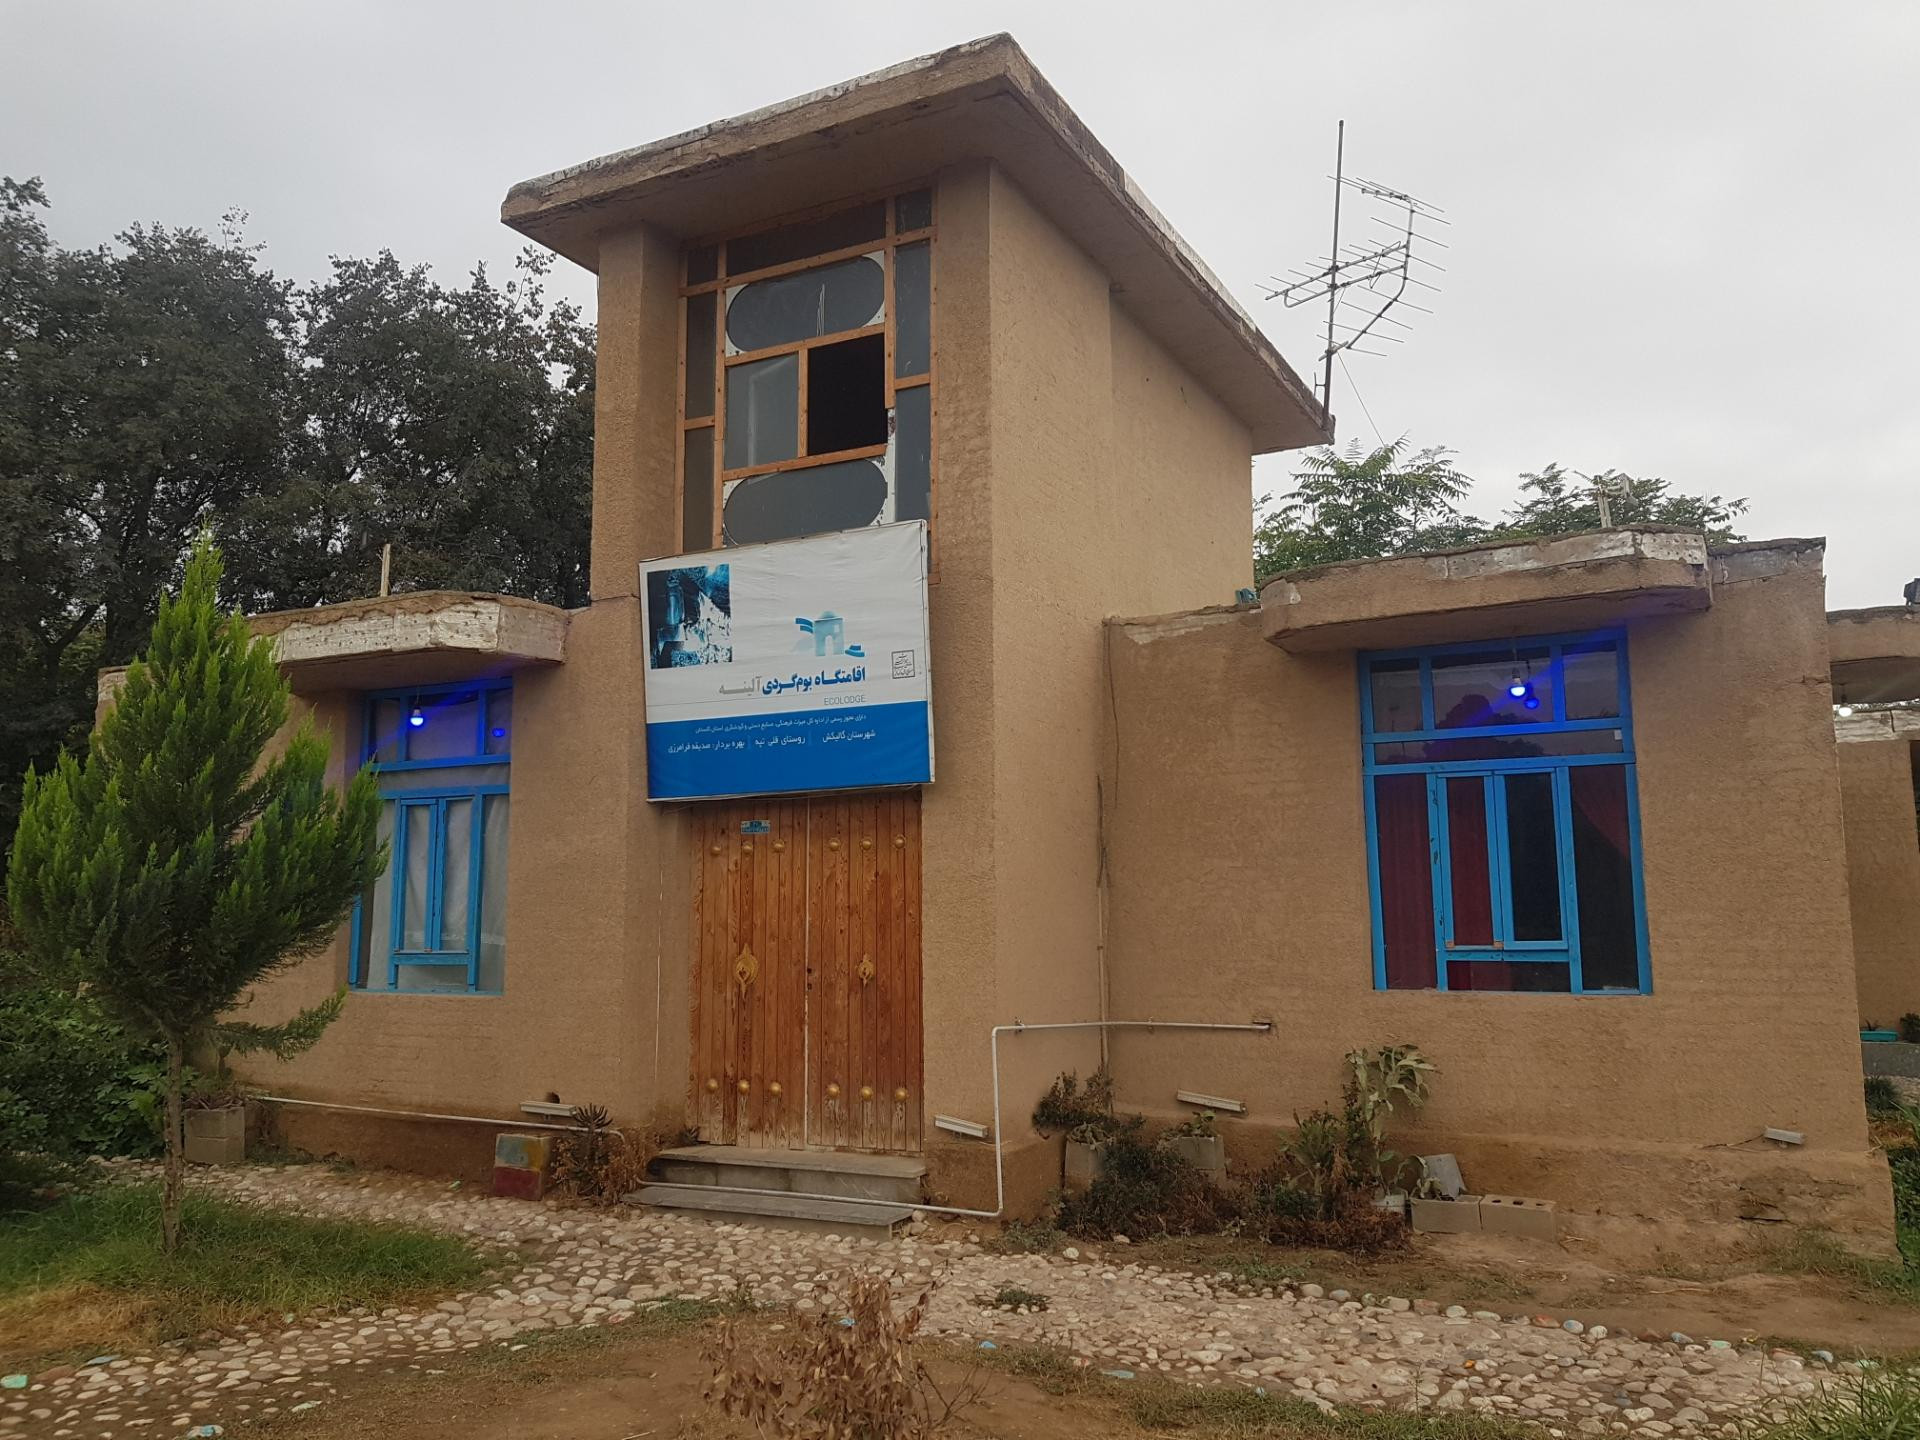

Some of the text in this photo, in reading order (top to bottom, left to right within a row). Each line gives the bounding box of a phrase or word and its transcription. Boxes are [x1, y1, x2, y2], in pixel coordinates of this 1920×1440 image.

[814, 666, 866, 686] اقامتگاه
[824, 694, 866, 706] ECOLODGE
[755, 736, 805, 748] روستای قلی تپه
[823, 729, 876, 743] شهرستان گالیکش
[668, 742, 691, 753] فرامرزی
[732, 739, 745, 749] بهره
